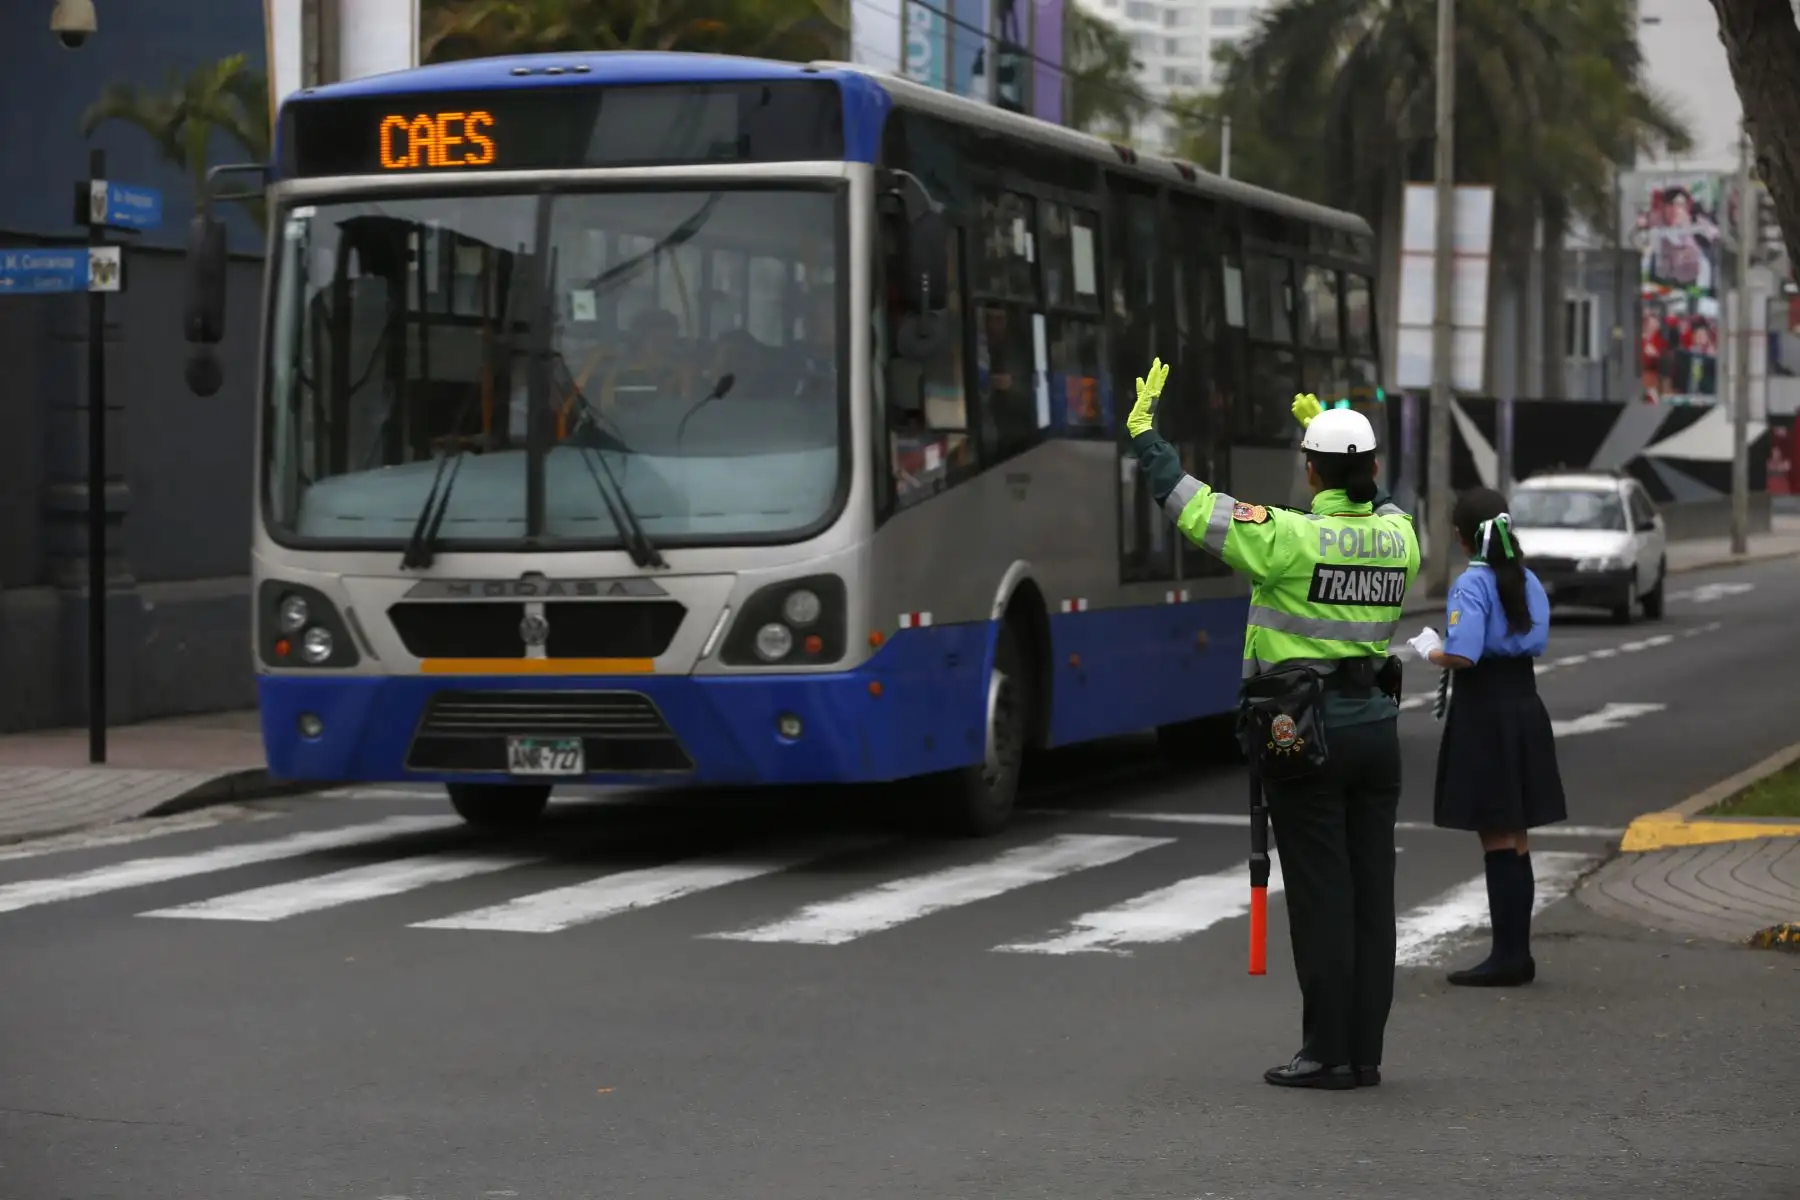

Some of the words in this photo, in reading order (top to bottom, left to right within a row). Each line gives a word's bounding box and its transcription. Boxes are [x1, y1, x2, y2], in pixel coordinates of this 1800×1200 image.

[380, 111, 495, 168] CAES
[1319, 527, 1408, 559] POLICIA
[1317, 568, 1405, 602] TRANSITO
